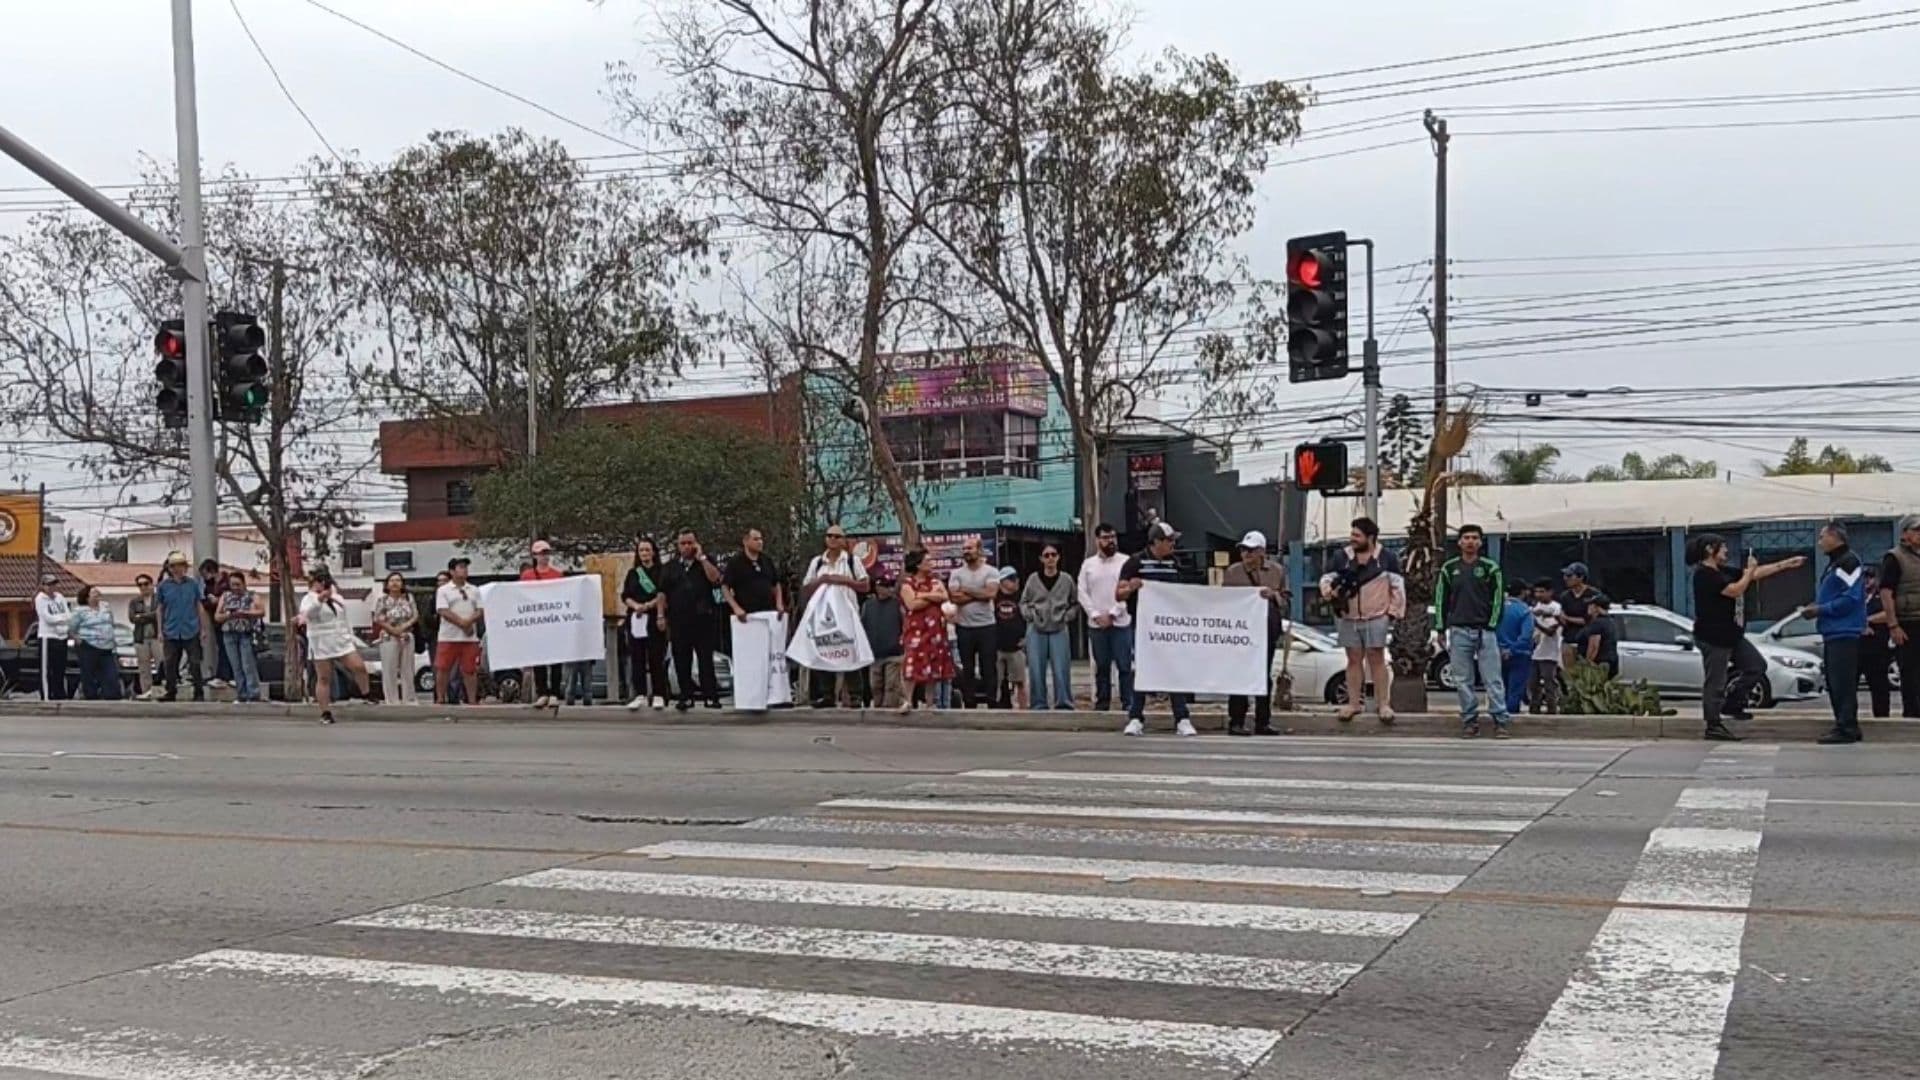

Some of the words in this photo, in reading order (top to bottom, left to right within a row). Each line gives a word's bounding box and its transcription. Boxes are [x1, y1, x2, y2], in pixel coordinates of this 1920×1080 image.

[517, 601, 562, 614] LIBERTAD
[564, 601, 570, 609] Y
[505, 613, 560, 628] SOBERANÍA
[1154, 615, 1199, 627] RECHAZO
[1202, 618, 1232, 629] TOTAL
[1235, 619, 1248, 630] AL
[1149, 631, 1200, 643] VIADUCTO
[1203, 633, 1253, 646] ELEVADO.
